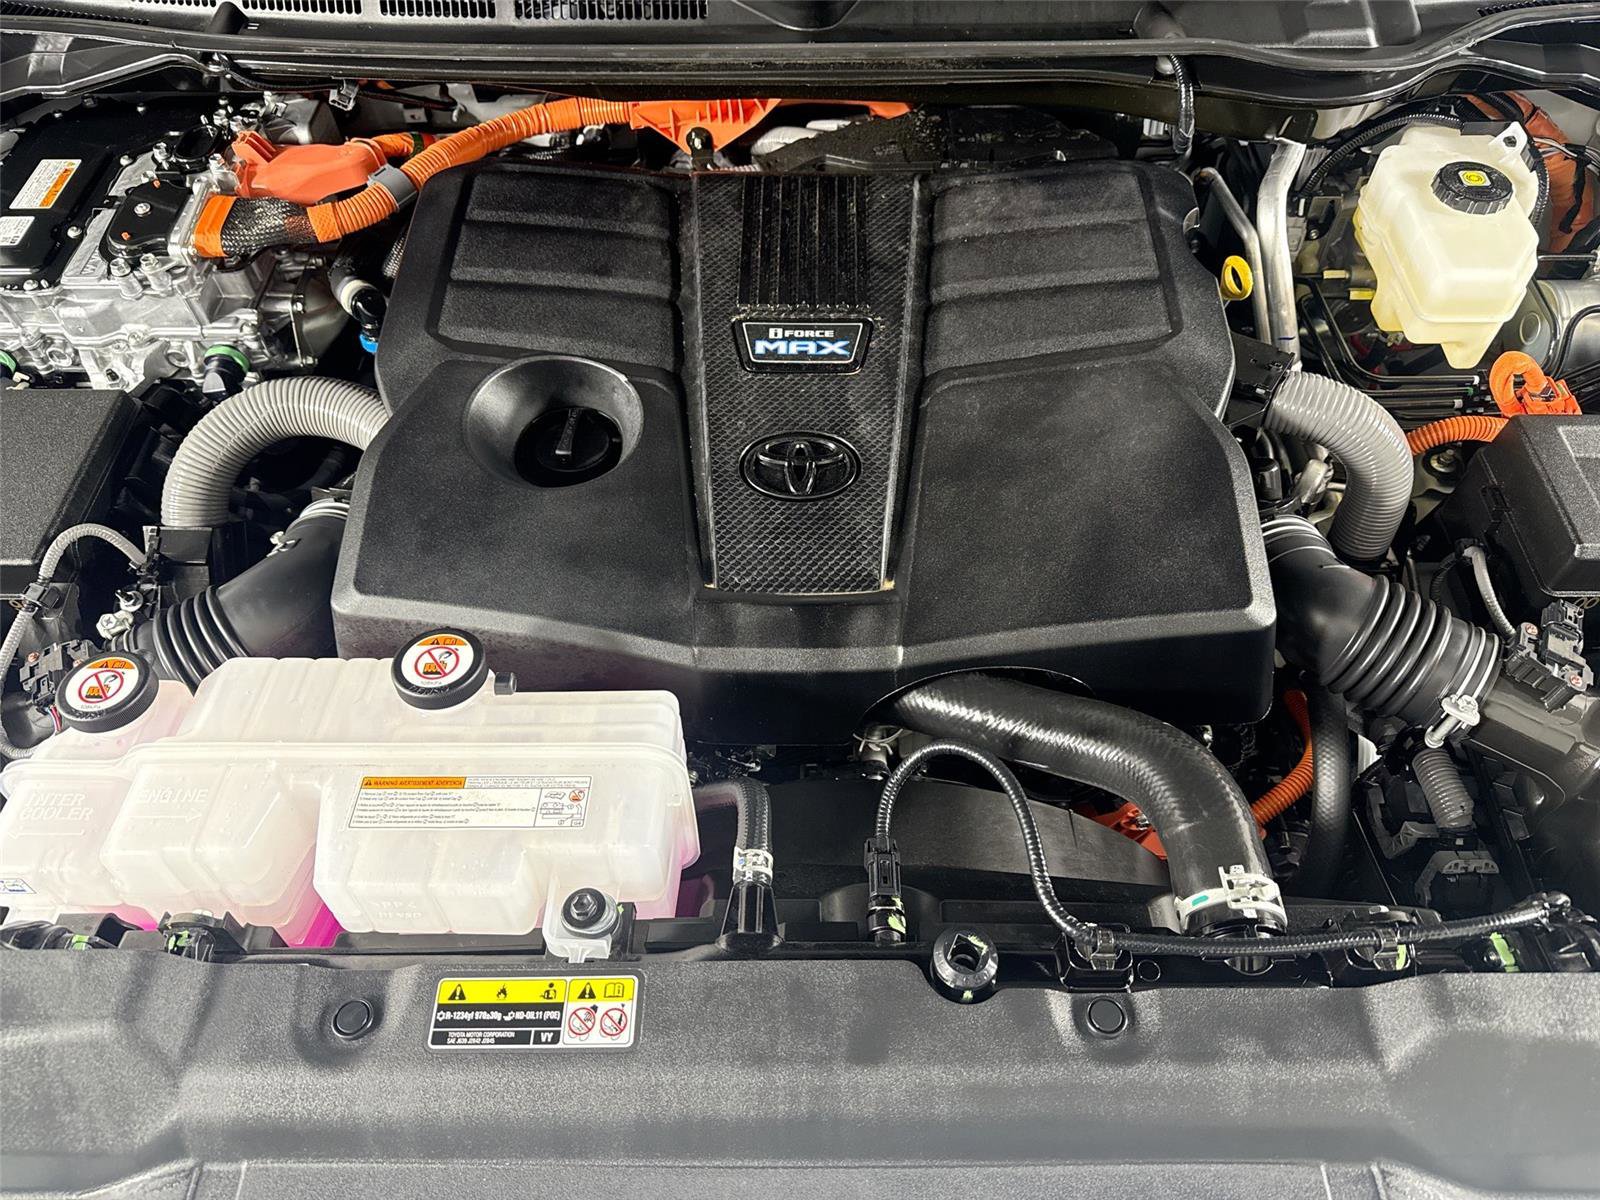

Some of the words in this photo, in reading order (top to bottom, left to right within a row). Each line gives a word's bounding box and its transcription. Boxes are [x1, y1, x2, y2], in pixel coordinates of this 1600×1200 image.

[784, 329, 835, 338] FORCE
[754, 340, 851, 355] MAX
[25, 792, 88, 807] INTER
[136, 788, 209, 804] ENGINE
[19, 807, 95, 821] COOLER
[445, 1011, 475, 1021] R-1234yf
[543, 1011, 561, 1021] (POE)
[540, 1032, 554, 1043] VY
